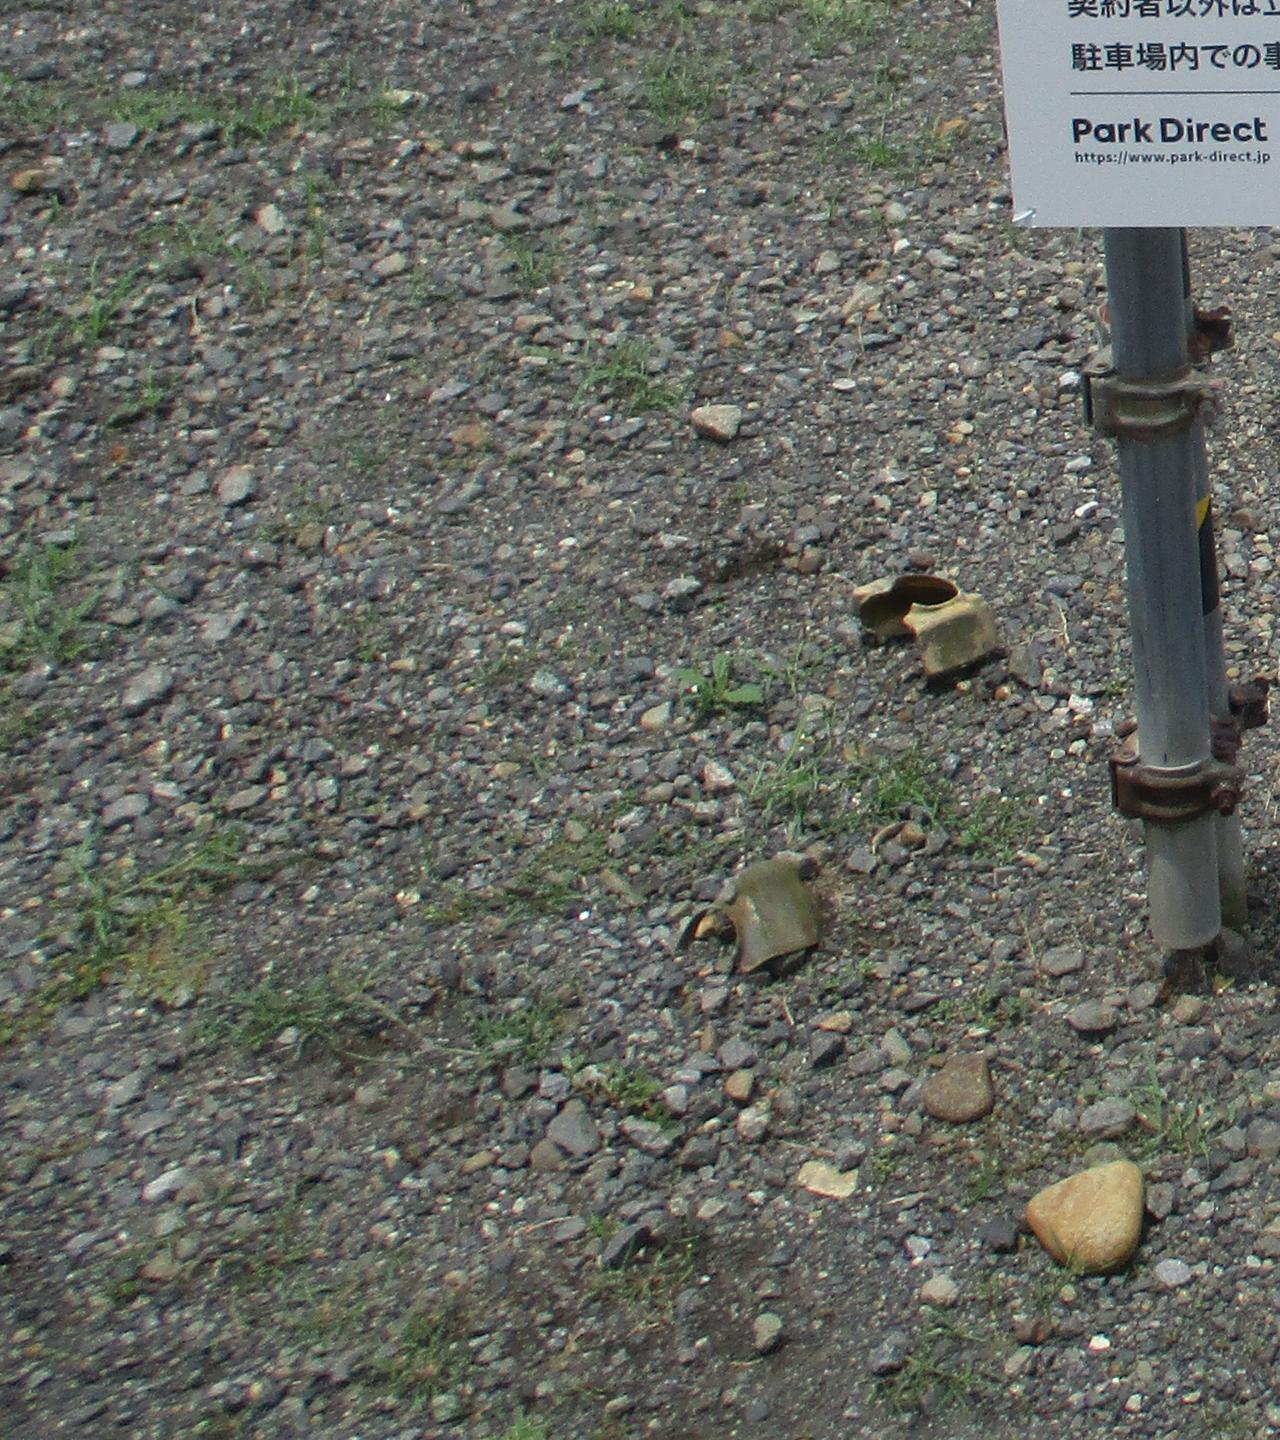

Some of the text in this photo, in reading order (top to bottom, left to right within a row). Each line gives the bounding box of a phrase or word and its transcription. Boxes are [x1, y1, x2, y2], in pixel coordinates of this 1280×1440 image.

[1071, 116, 1269, 144] Park Direct
[1074, 150, 1272, 166] https://www.park-direct.jp
